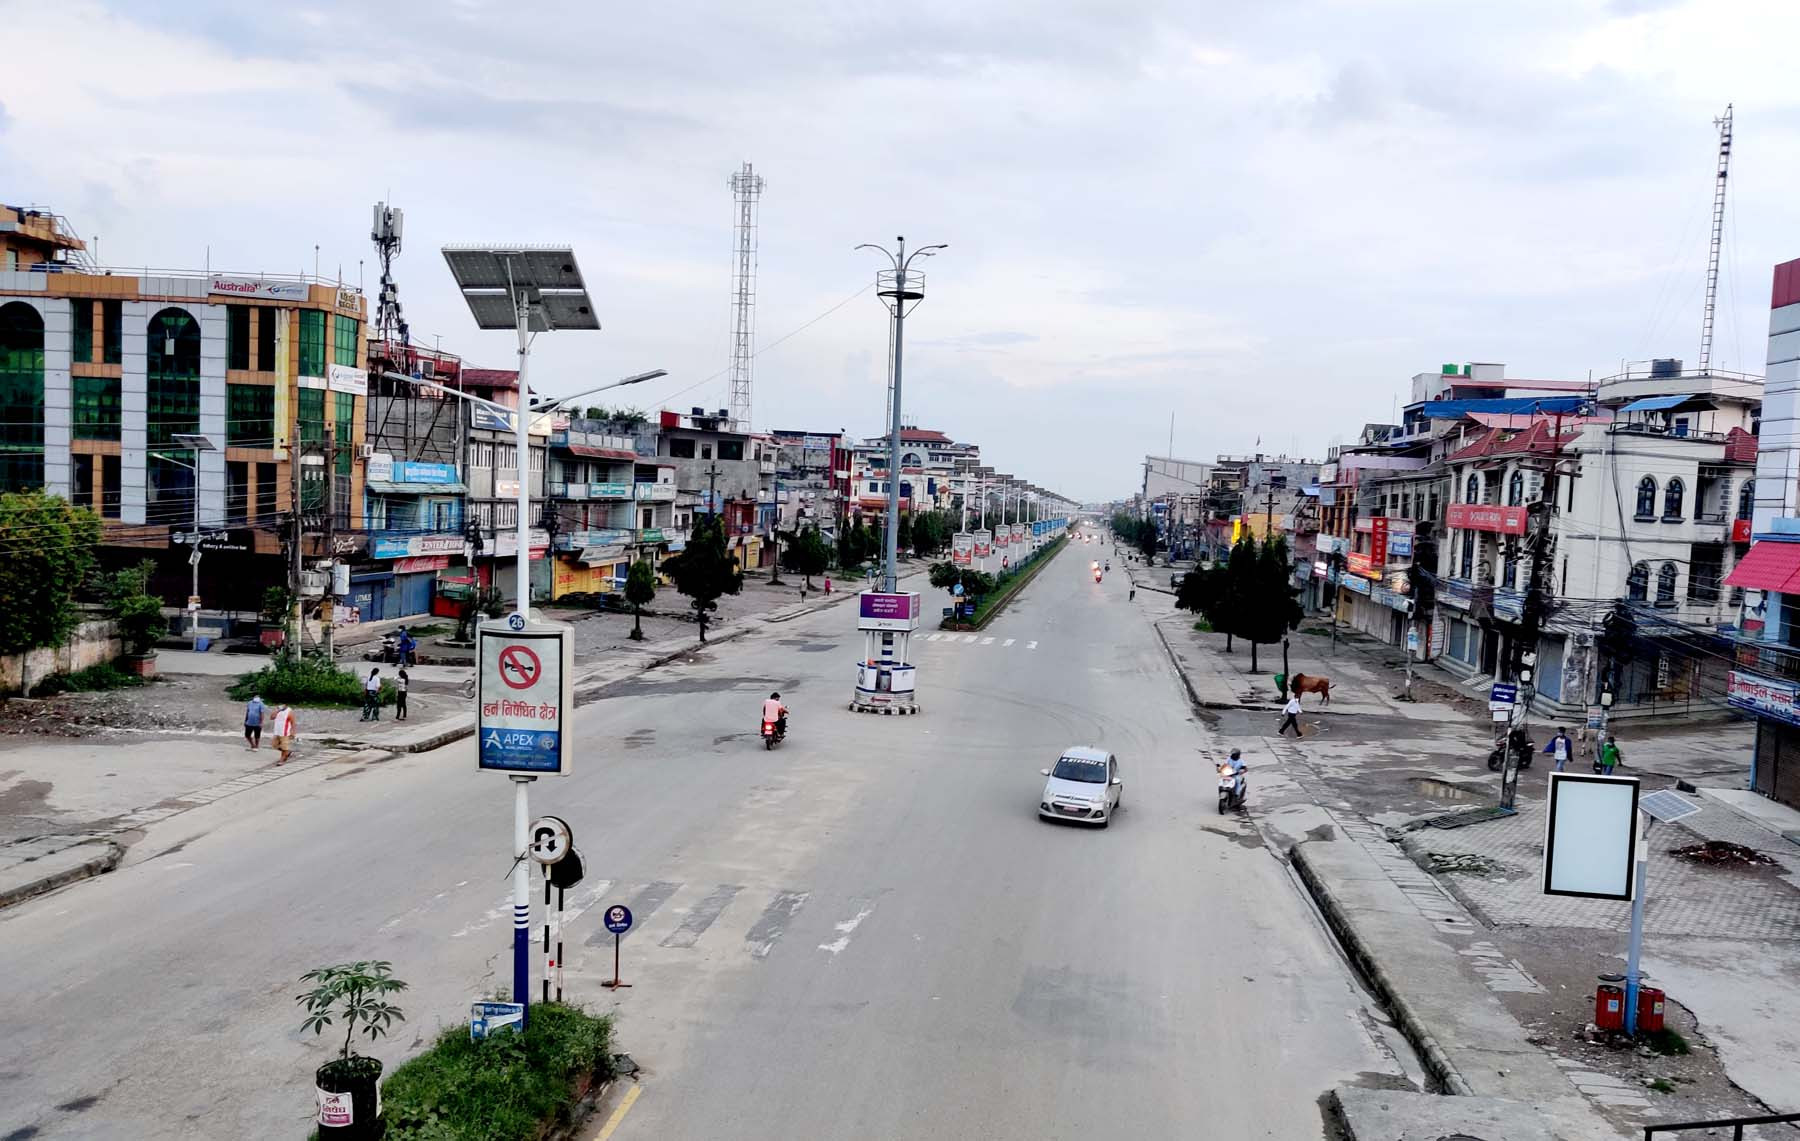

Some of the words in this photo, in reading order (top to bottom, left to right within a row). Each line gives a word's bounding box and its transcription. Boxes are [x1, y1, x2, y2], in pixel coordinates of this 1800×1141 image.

[213, 280, 256, 293] Australia
[511, 617, 523, 628] 26
[539, 702, 557, 721] क्षेत्र
[503, 733, 535, 746] APEX
